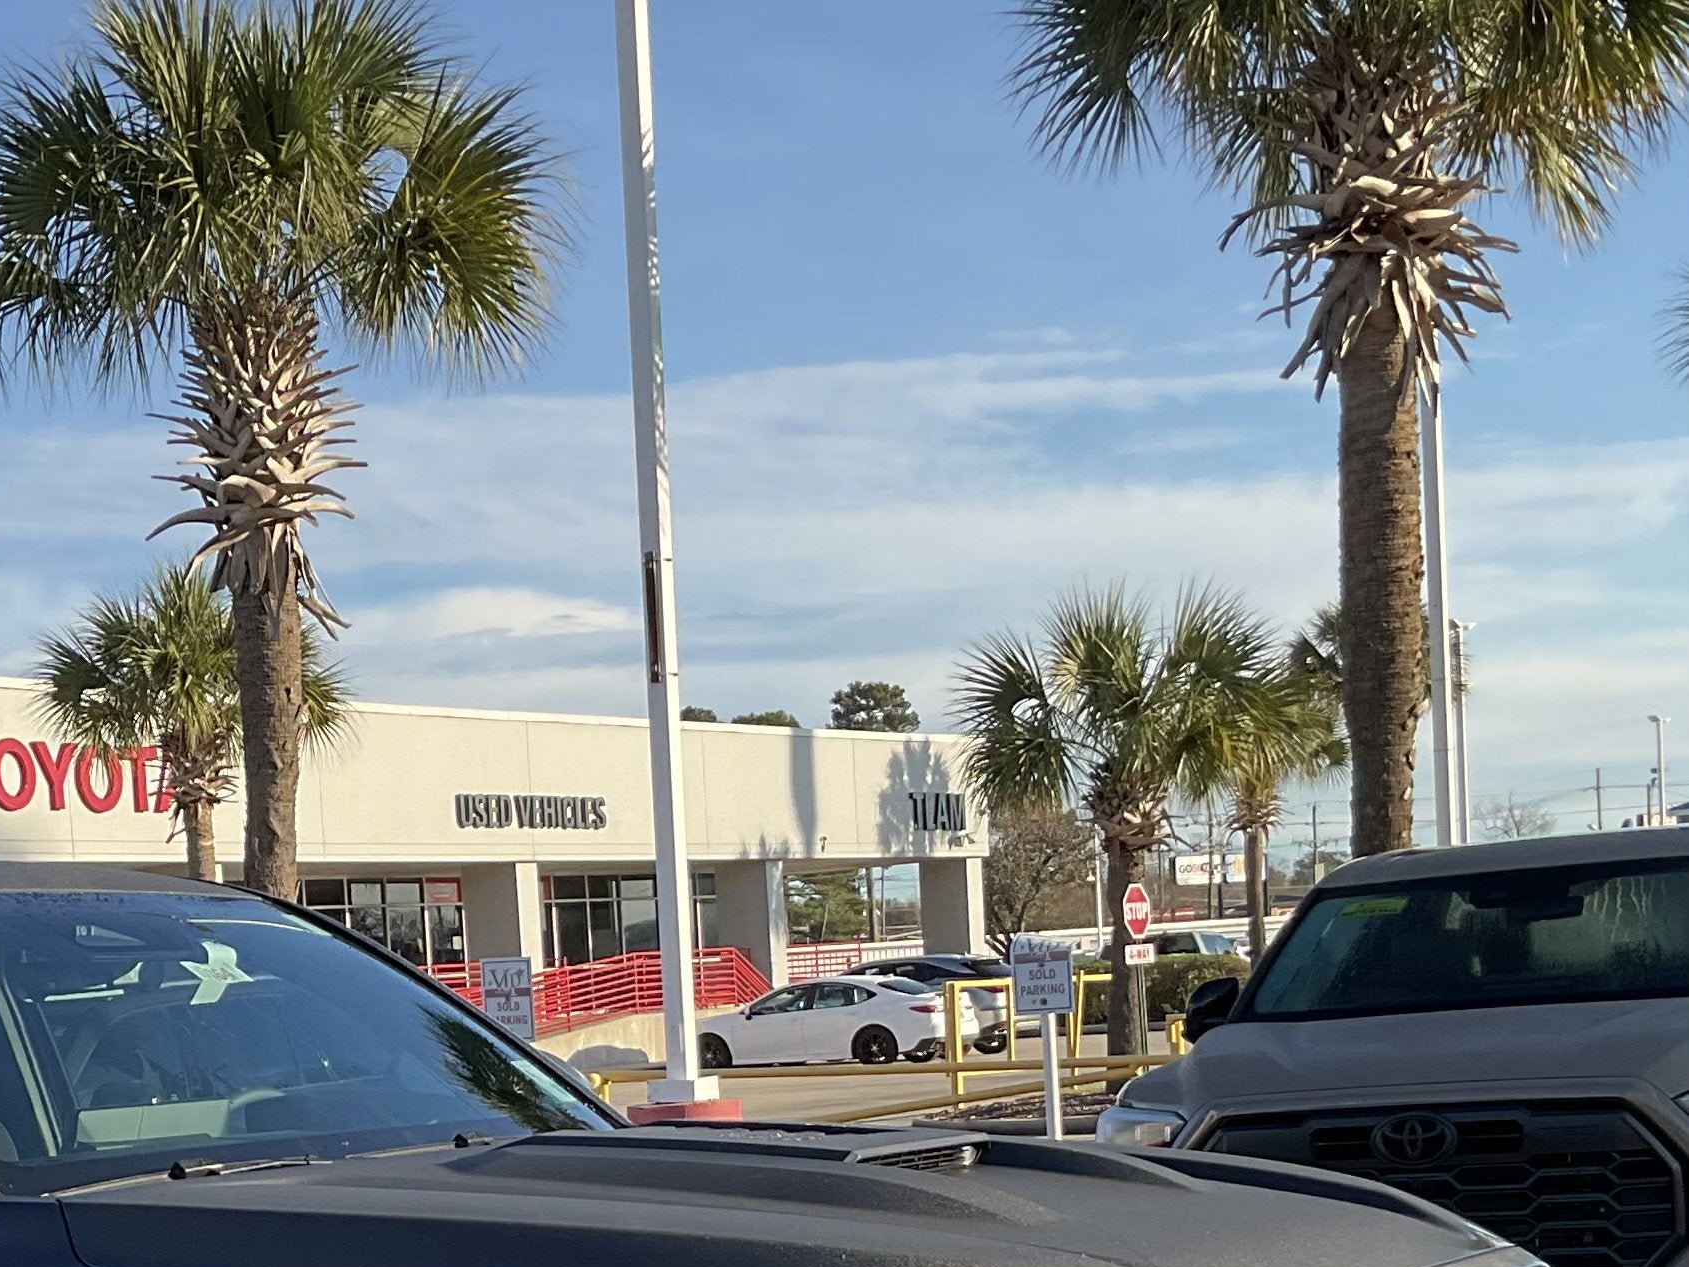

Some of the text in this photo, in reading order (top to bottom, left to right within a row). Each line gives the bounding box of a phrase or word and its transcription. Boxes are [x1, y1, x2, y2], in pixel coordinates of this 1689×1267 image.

[455, 794, 607, 830] USED VEHICLES
[1126, 902, 1148, 920] STOP
[1129, 947, 1150, 960] 4-WAY
[1028, 968, 1056, 981] SOLD
[1020, 982, 1065, 997] PARKING
[496, 1001, 520, 1012] SOLD
[494, 1014, 528, 1025] ARKING
